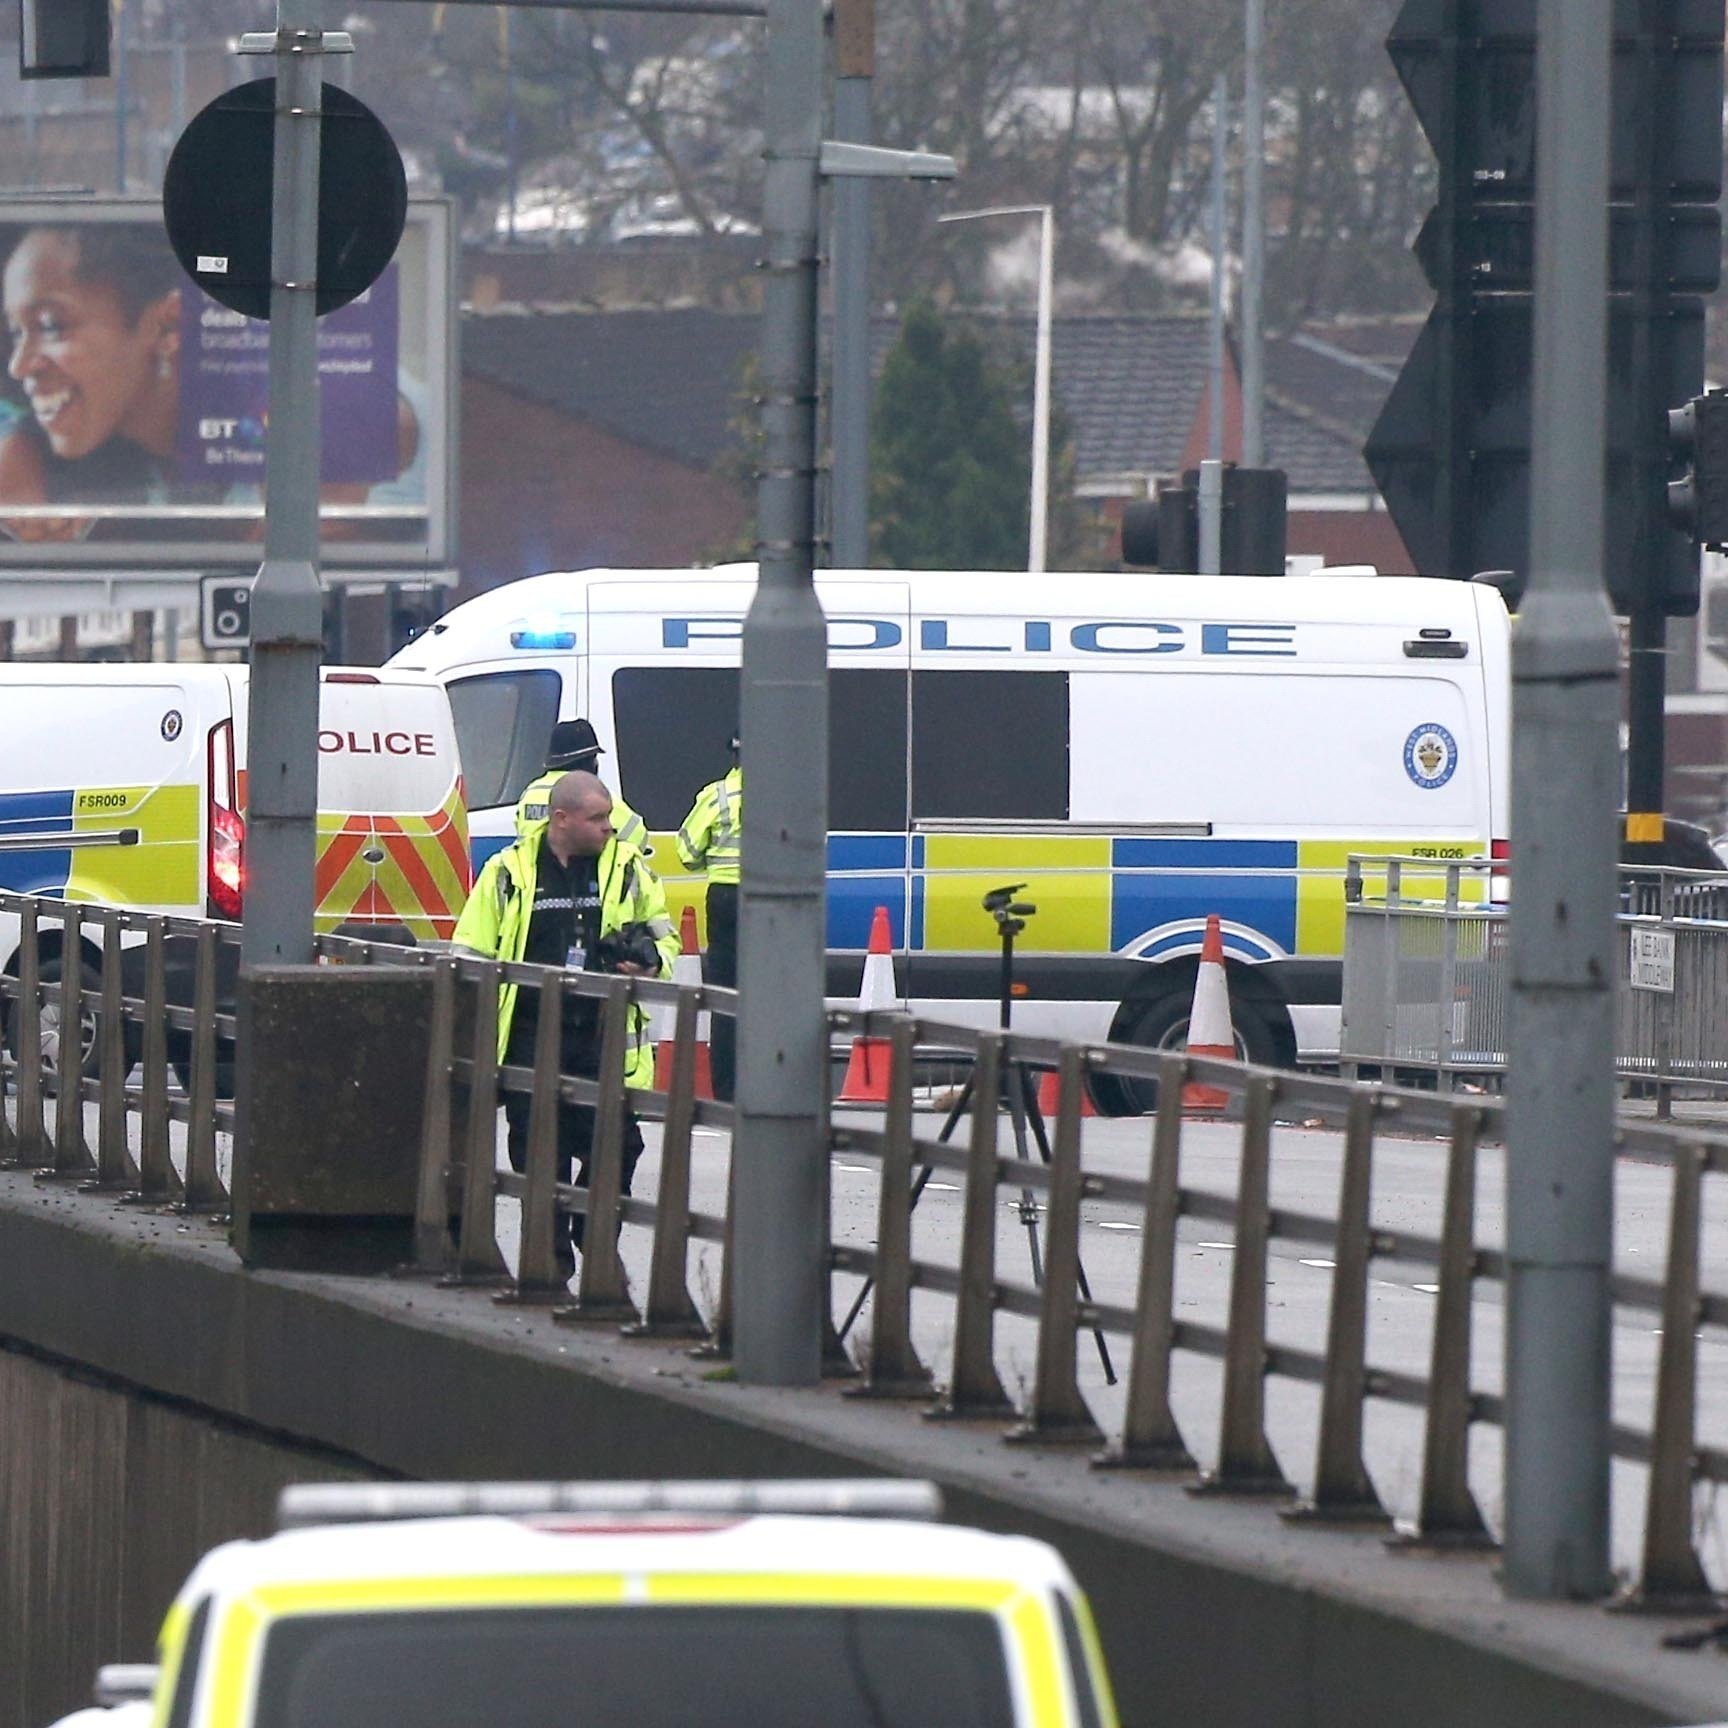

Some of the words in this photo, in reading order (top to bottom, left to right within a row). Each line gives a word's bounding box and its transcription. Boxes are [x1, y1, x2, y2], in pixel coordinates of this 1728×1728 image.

[199, 418, 237, 439] BT
[661, 617, 1298, 657] POLICE
[318, 730, 437, 756] OLICE
[79, 794, 127, 808] FSR009
